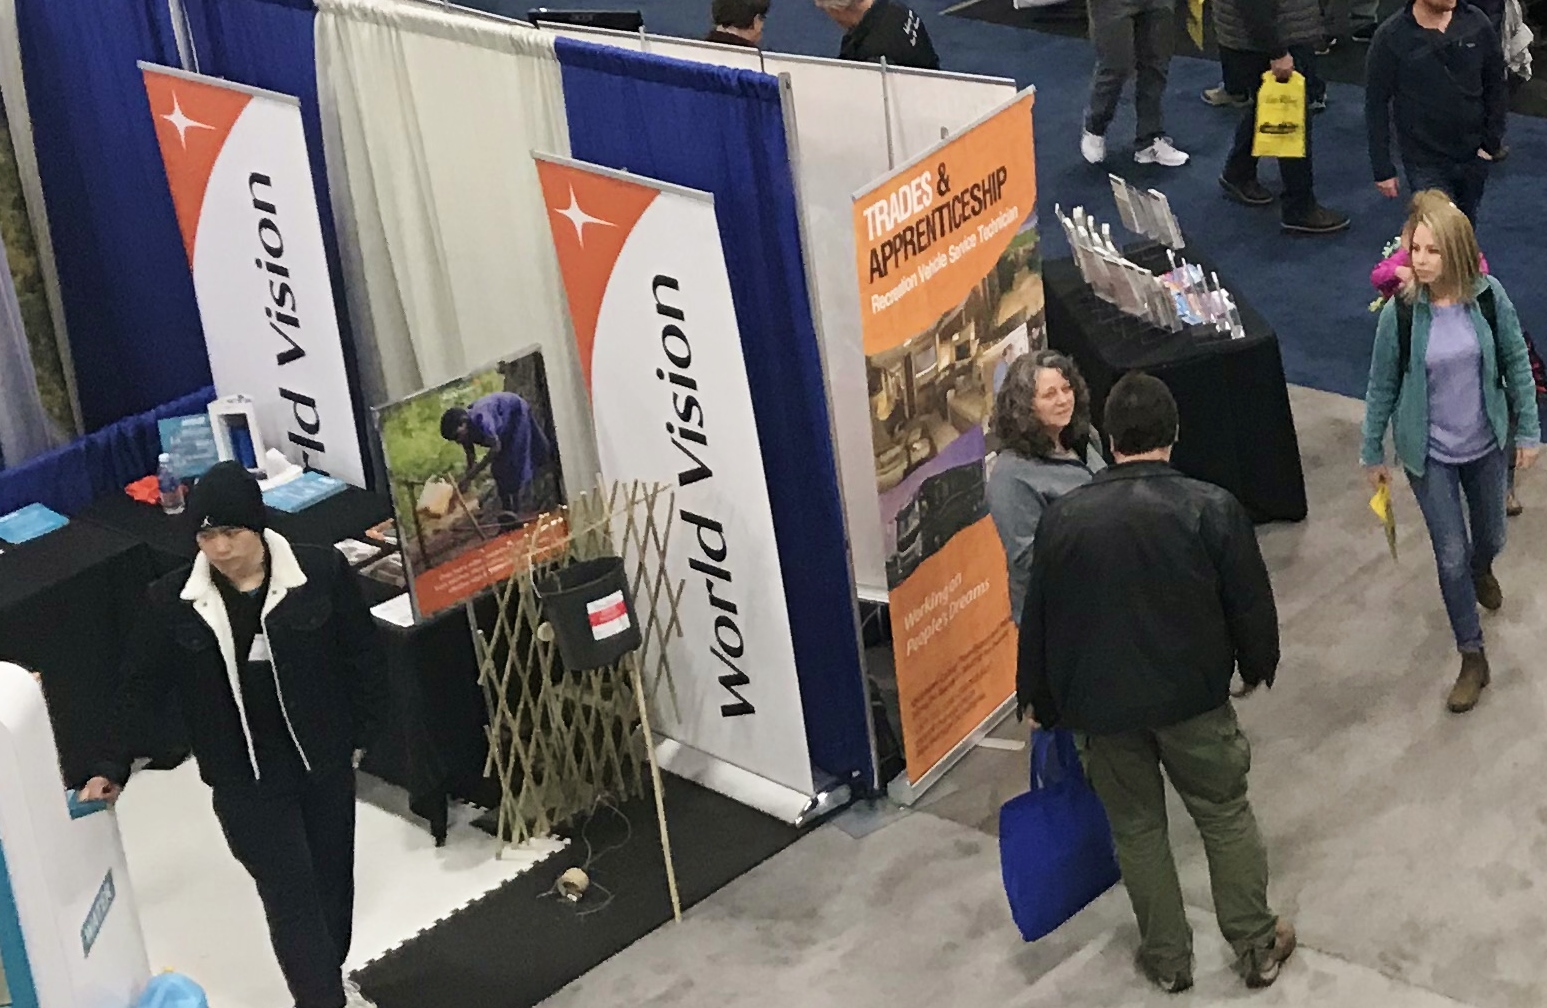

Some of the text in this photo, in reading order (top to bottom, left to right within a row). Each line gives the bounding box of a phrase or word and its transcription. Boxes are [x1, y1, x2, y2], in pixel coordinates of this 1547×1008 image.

[863, 162, 951, 241] TRADES &
[869, 165, 1007, 284] APPRENTICESHIP
[871, 205, 1019, 314] Recreation Vehicle Service Technician
[248, 171, 331, 477] rld Vision
[650, 273, 756, 719] World Vision
[903, 572, 963, 631] Working on
[906, 578, 990, 657] People's Dreams
